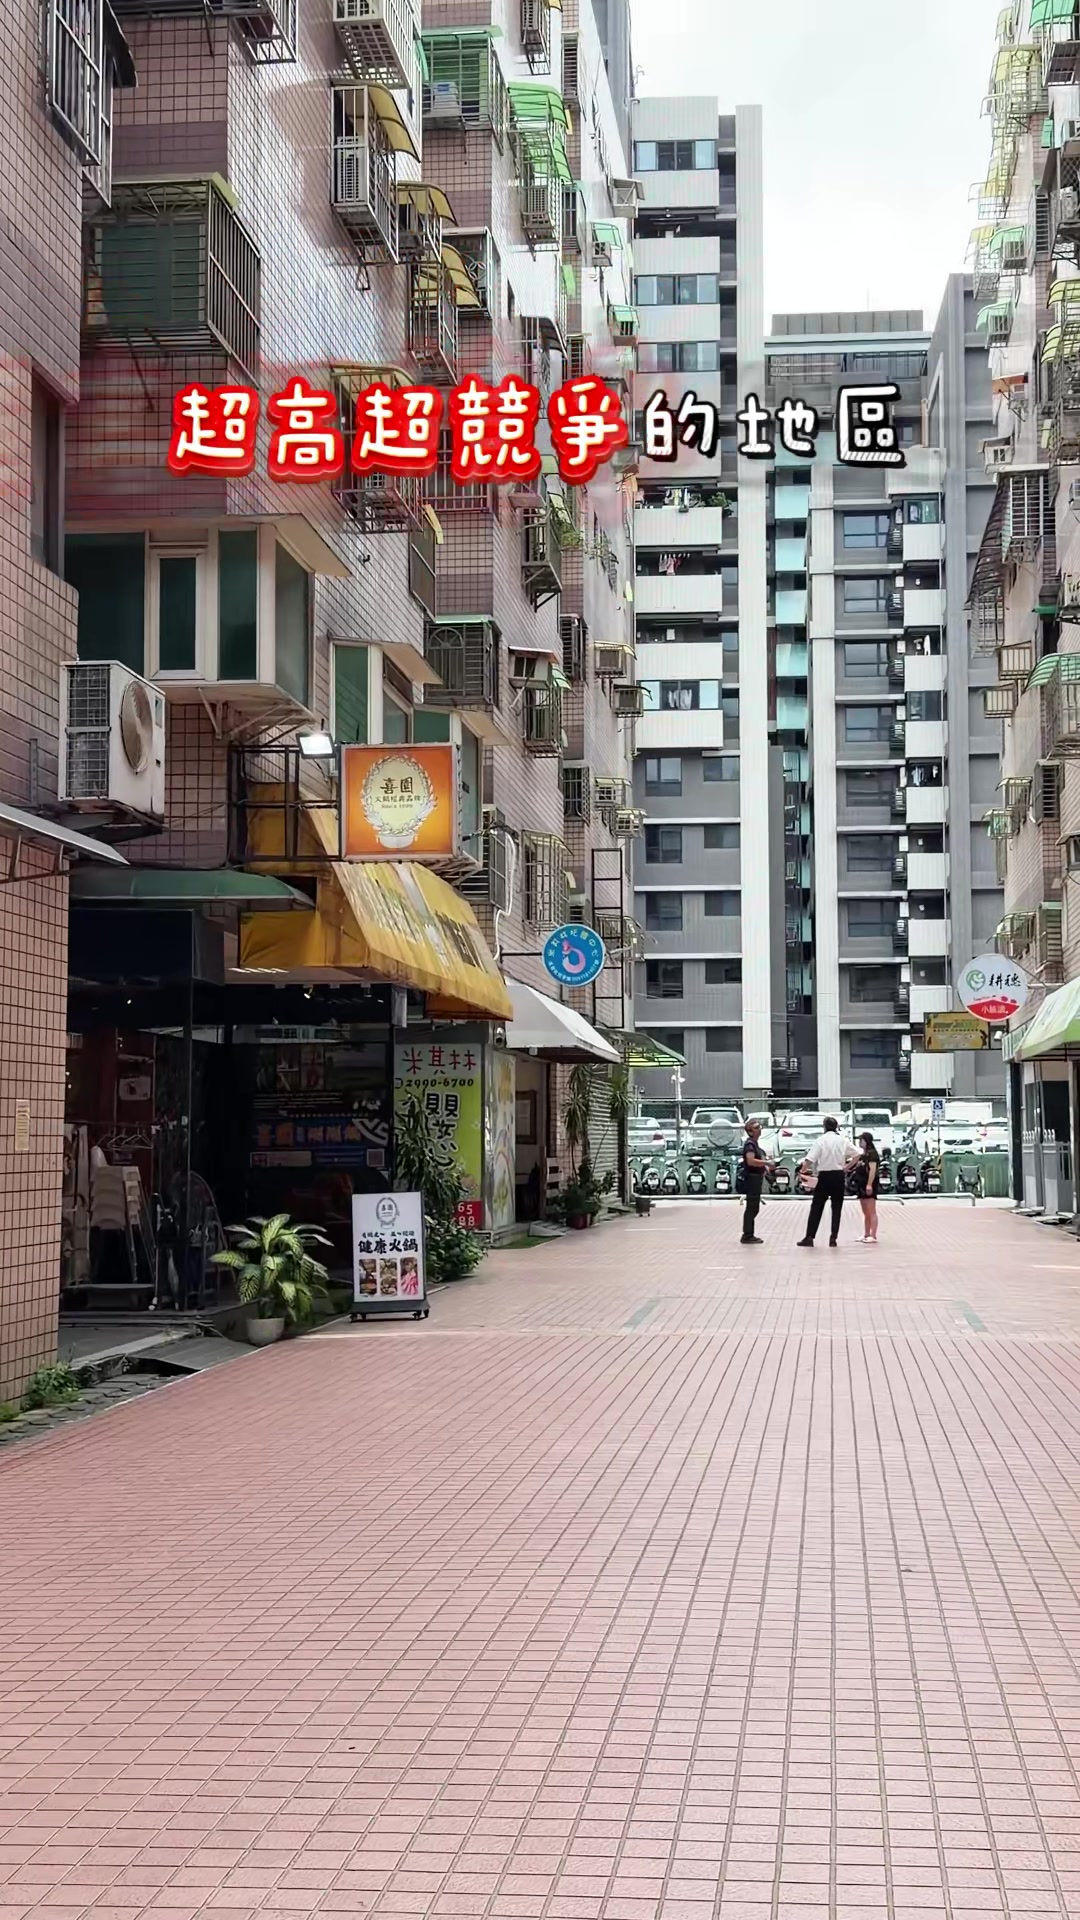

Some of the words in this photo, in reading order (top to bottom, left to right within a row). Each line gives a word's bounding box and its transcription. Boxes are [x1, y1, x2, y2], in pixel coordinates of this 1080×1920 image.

[401, 1045, 476, 1075] 米其林
[406, 1078, 474, 1088] 2990-6700
[358, 1238, 418, 1254] 健康火鍋
